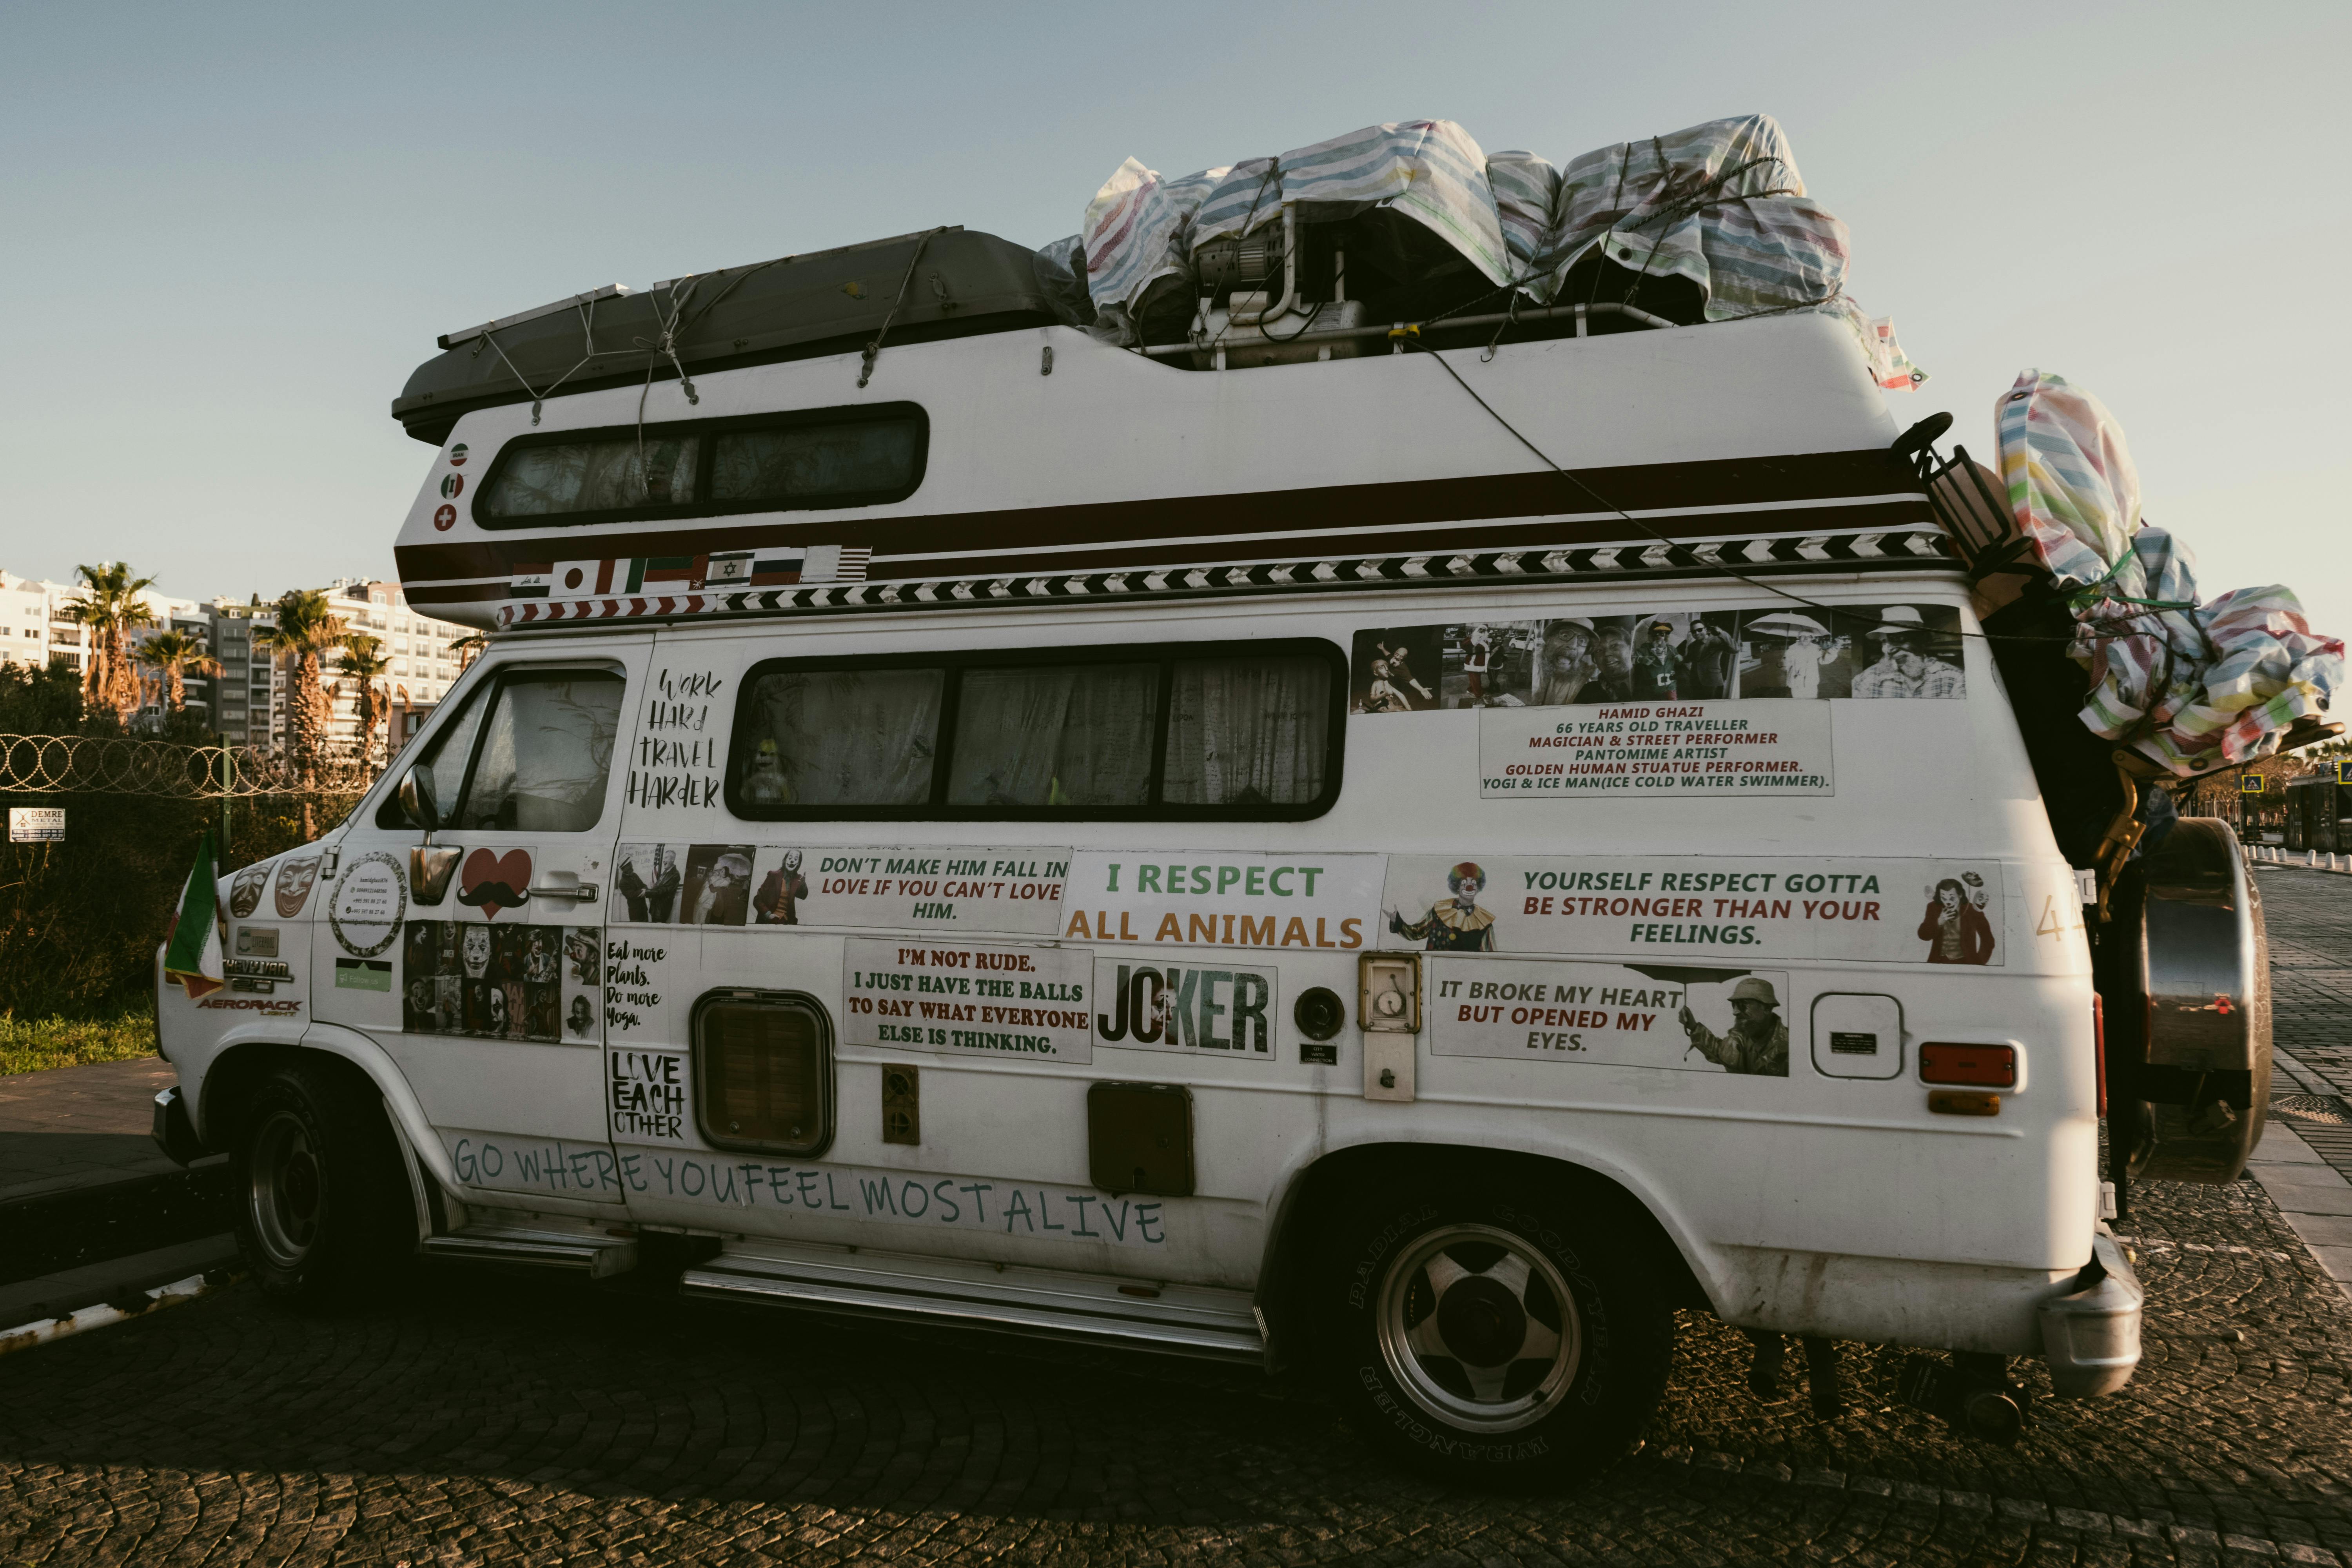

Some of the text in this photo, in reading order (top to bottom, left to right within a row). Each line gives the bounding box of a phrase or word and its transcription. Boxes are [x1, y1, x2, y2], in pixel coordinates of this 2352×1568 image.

[1599, 707, 1704, 719] HAMID GHAZI
[1557, 720, 1748, 733] 66 YEARS OLD TRAVELLER
[1529, 733, 1777, 747] MAGICIAN & STREET PERFORMER
[1576, 748, 1728, 760] PANTOMIME ARTIST
[1506, 762, 1802, 775] GOLDEN HUMAN STUATUE PERFORMER.
[1484, 779, 1517, 789] YOGI
[1521, 779, 1532, 788] &
[1537, 778, 1560, 788] ICE
[1635, 777, 1674, 787] COLD
[1681, 776, 1733, 786] WATER
[1740, 776, 1829, 788] SWIMMER).
[820, 858, 1068, 877] DON'T MAKE HIM FALL IN
[822, 879, 1061, 900] LOVE IF YOU CAN'T LOVE
[1107, 864, 1323, 897] I RESPECT
[1524, 872, 1879, 893] YOURSELF RESPECT GOTTA
[913, 903, 956, 919] HIM.
[1524, 897, 1880, 920] BE STRONGER THAN YOUR
[1065, 911, 1362, 949] ALL ANIMALS
[1631, 924, 1761, 944] FEELINGS.
[607, 940, 667, 962] Eat more
[931, 951, 970, 968] NOT
[975, 953, 1035, 972] RUDE.
[607, 962, 650, 986] Plants.
[607, 987, 661, 1007] Do more
[855, 972, 1082, 1002] I JUST HAVE THE BALLS
[1440, 981, 1683, 1008] IT BROKE MY HEART
[607, 1007, 641, 1030] Yoga.
[849, 997, 1088, 1029] TO SAY WHAT EVERYONE
[1098, 964, 1269, 1053] JOKER
[1458, 1005, 1656, 1031] BUT OPENED MY
[878, 1025, 1056, 1054] ELSE IS THINKING.
[1527, 1032, 1586, 1051] EYES.
[612, 1051, 681, 1083] LOVE
[612, 1081, 687, 1115] EACH
[614, 1111, 683, 1140] OTHER
[455, 1138, 1165, 1243] GO WHERE YOU FEEL MOST ALIVE
[1349, 1204, 1438, 1309] RADIAL
[1359, 1366, 1549, 1462] WRANGLER
